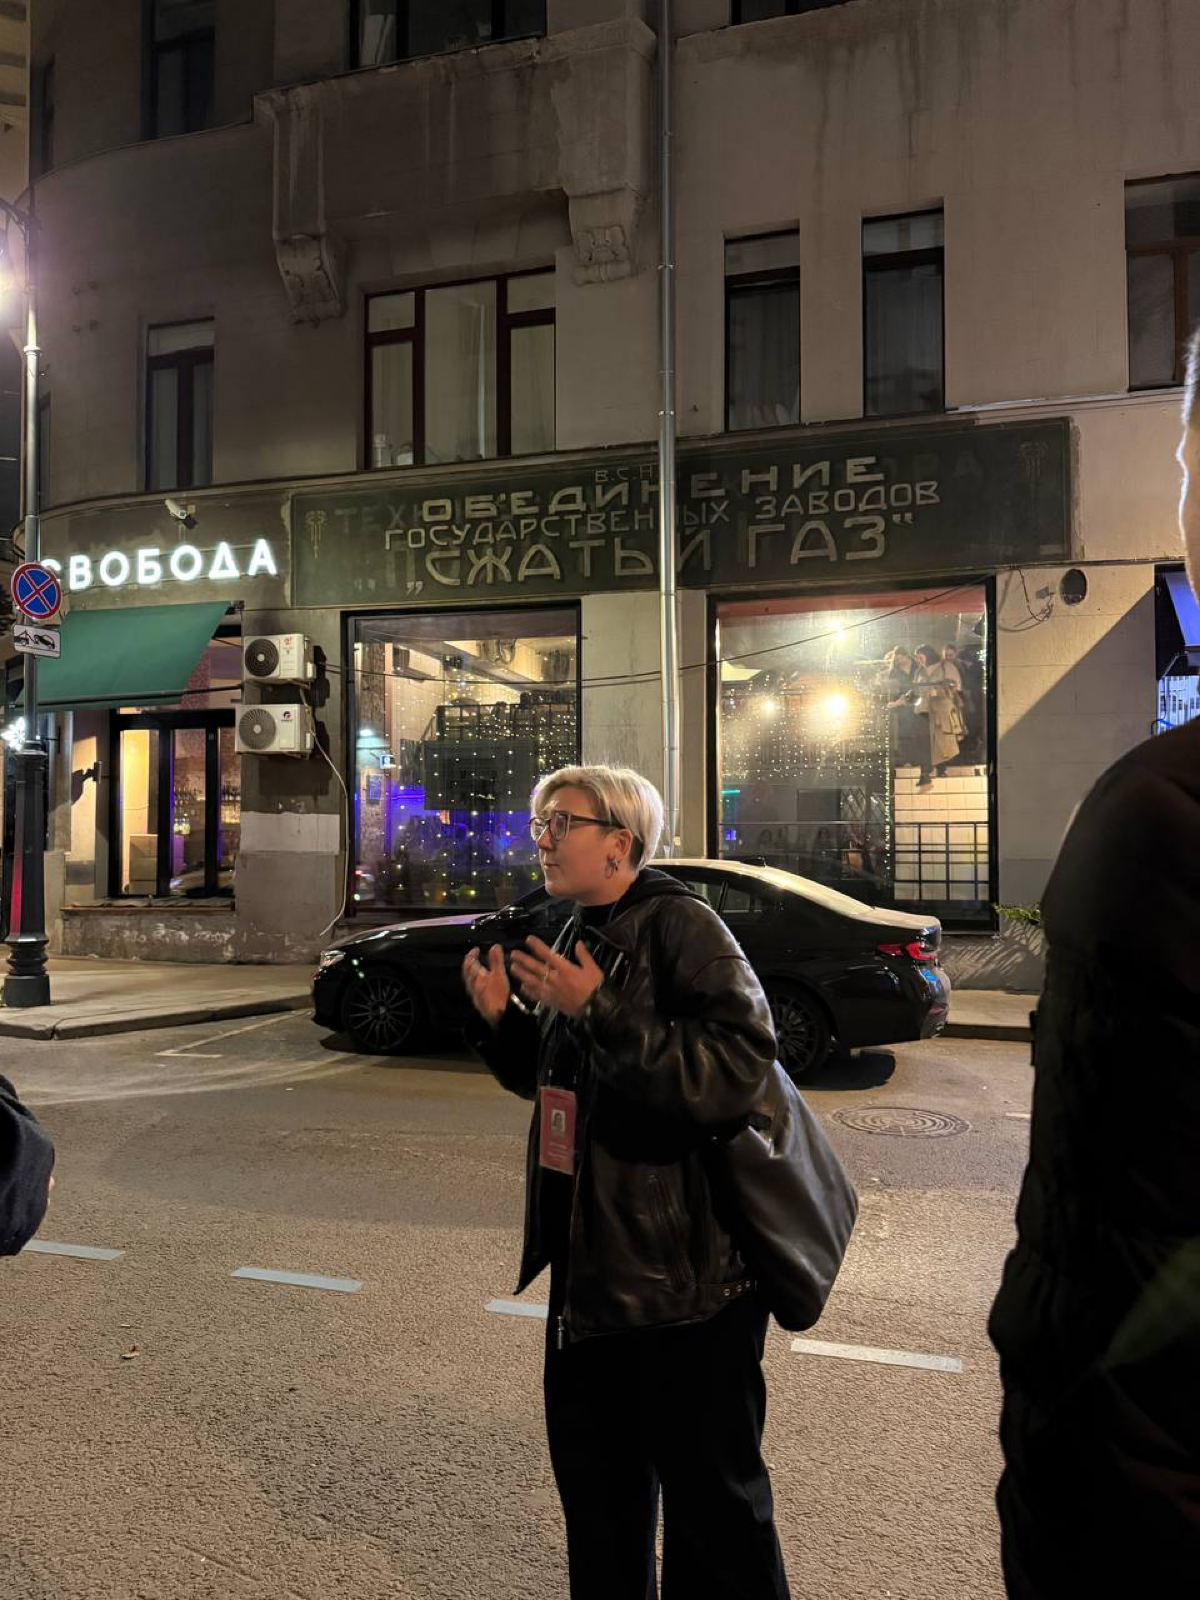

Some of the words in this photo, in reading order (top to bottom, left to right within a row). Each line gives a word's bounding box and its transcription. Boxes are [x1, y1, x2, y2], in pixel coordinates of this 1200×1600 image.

[384, 499, 731, 550] ГОСУДАРСТВЕНЫХ
[755, 480, 941, 520] ЗАВОДОВ
[40, 538, 278, 591] ВОБОДА
